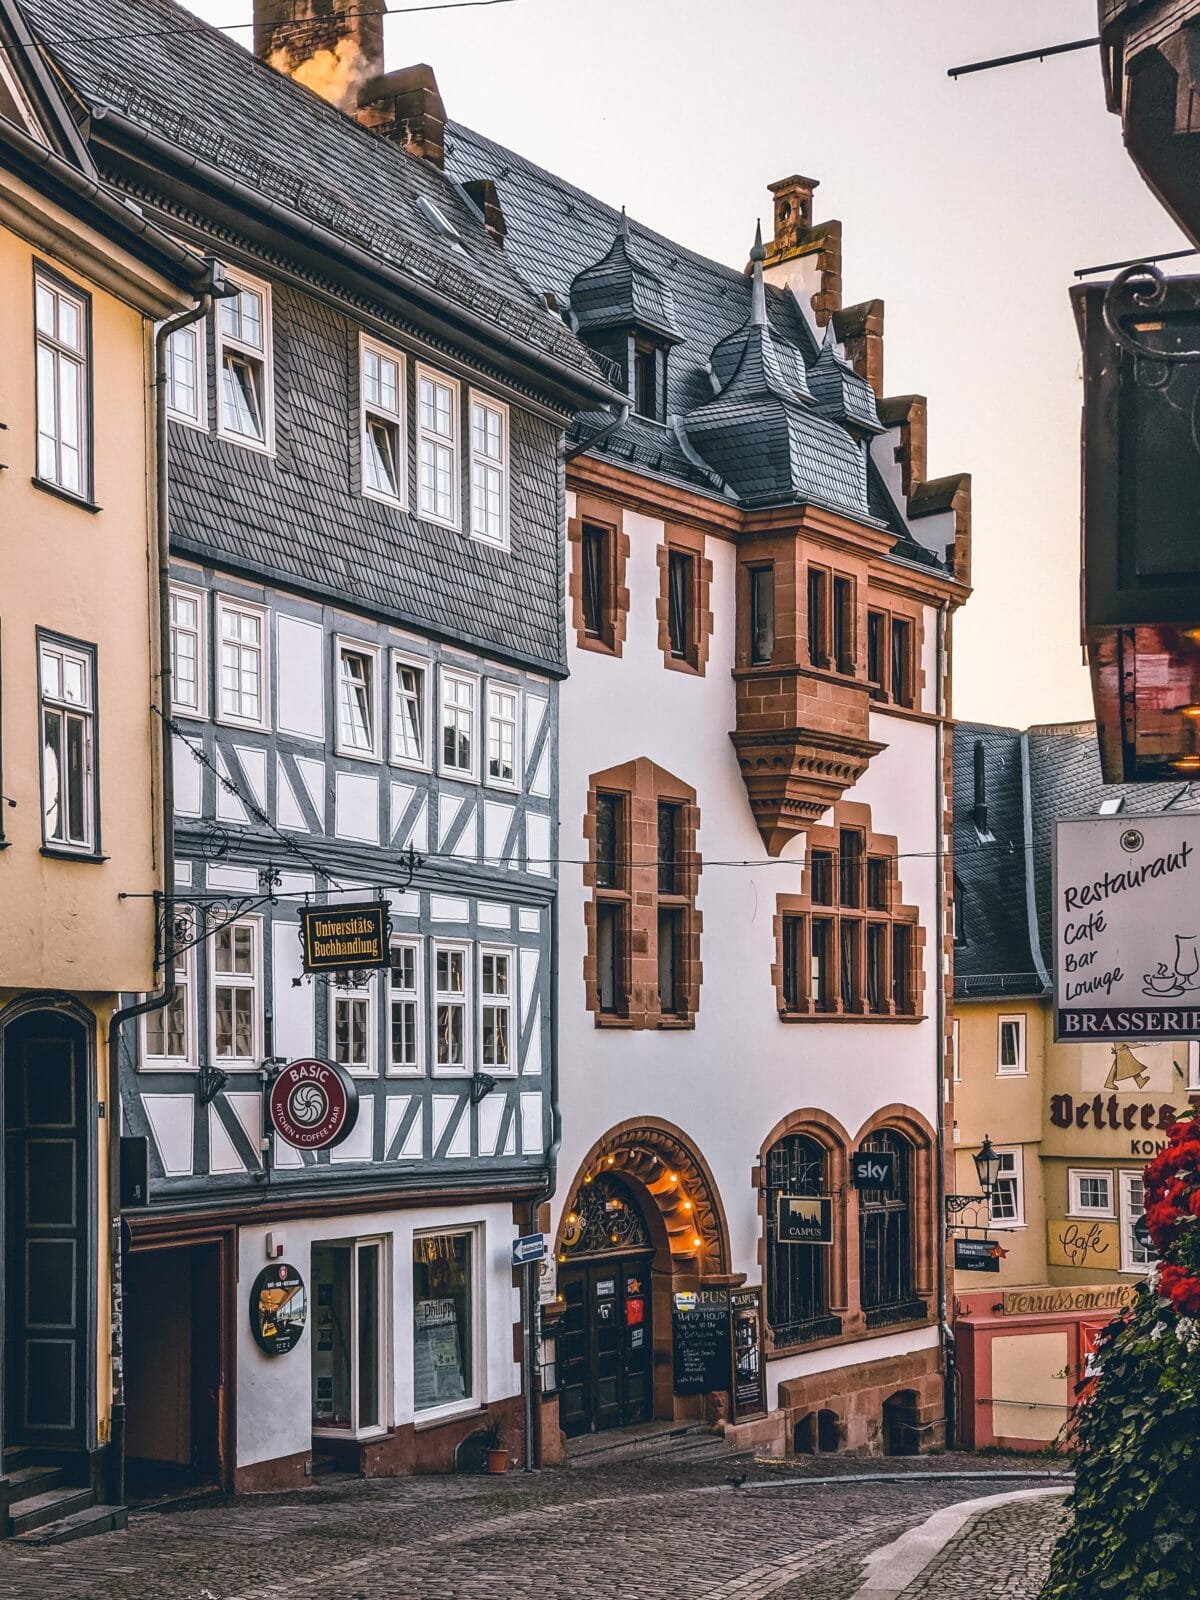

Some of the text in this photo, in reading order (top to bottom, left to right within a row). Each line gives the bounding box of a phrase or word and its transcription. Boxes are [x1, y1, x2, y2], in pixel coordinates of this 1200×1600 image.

[1064, 841, 1194, 912] Restaurant
[1064, 910, 1108, 944] Café
[314, 937, 378, 957] Buchhandlung
[1065, 951, 1098, 972] Bar
[1065, 967, 1124, 1001] Lounge
[289, 1065, 330, 1083] BASIC
[276, 1103, 341, 1142] KITCHEN COFFEE BAR
[857, 1160, 888, 1182] sky
[789, 1227, 822, 1237] CAMPUS
[1059, 1223, 1109, 1265] Café
[1005, 1285, 1130, 1314] Terrassencafé
